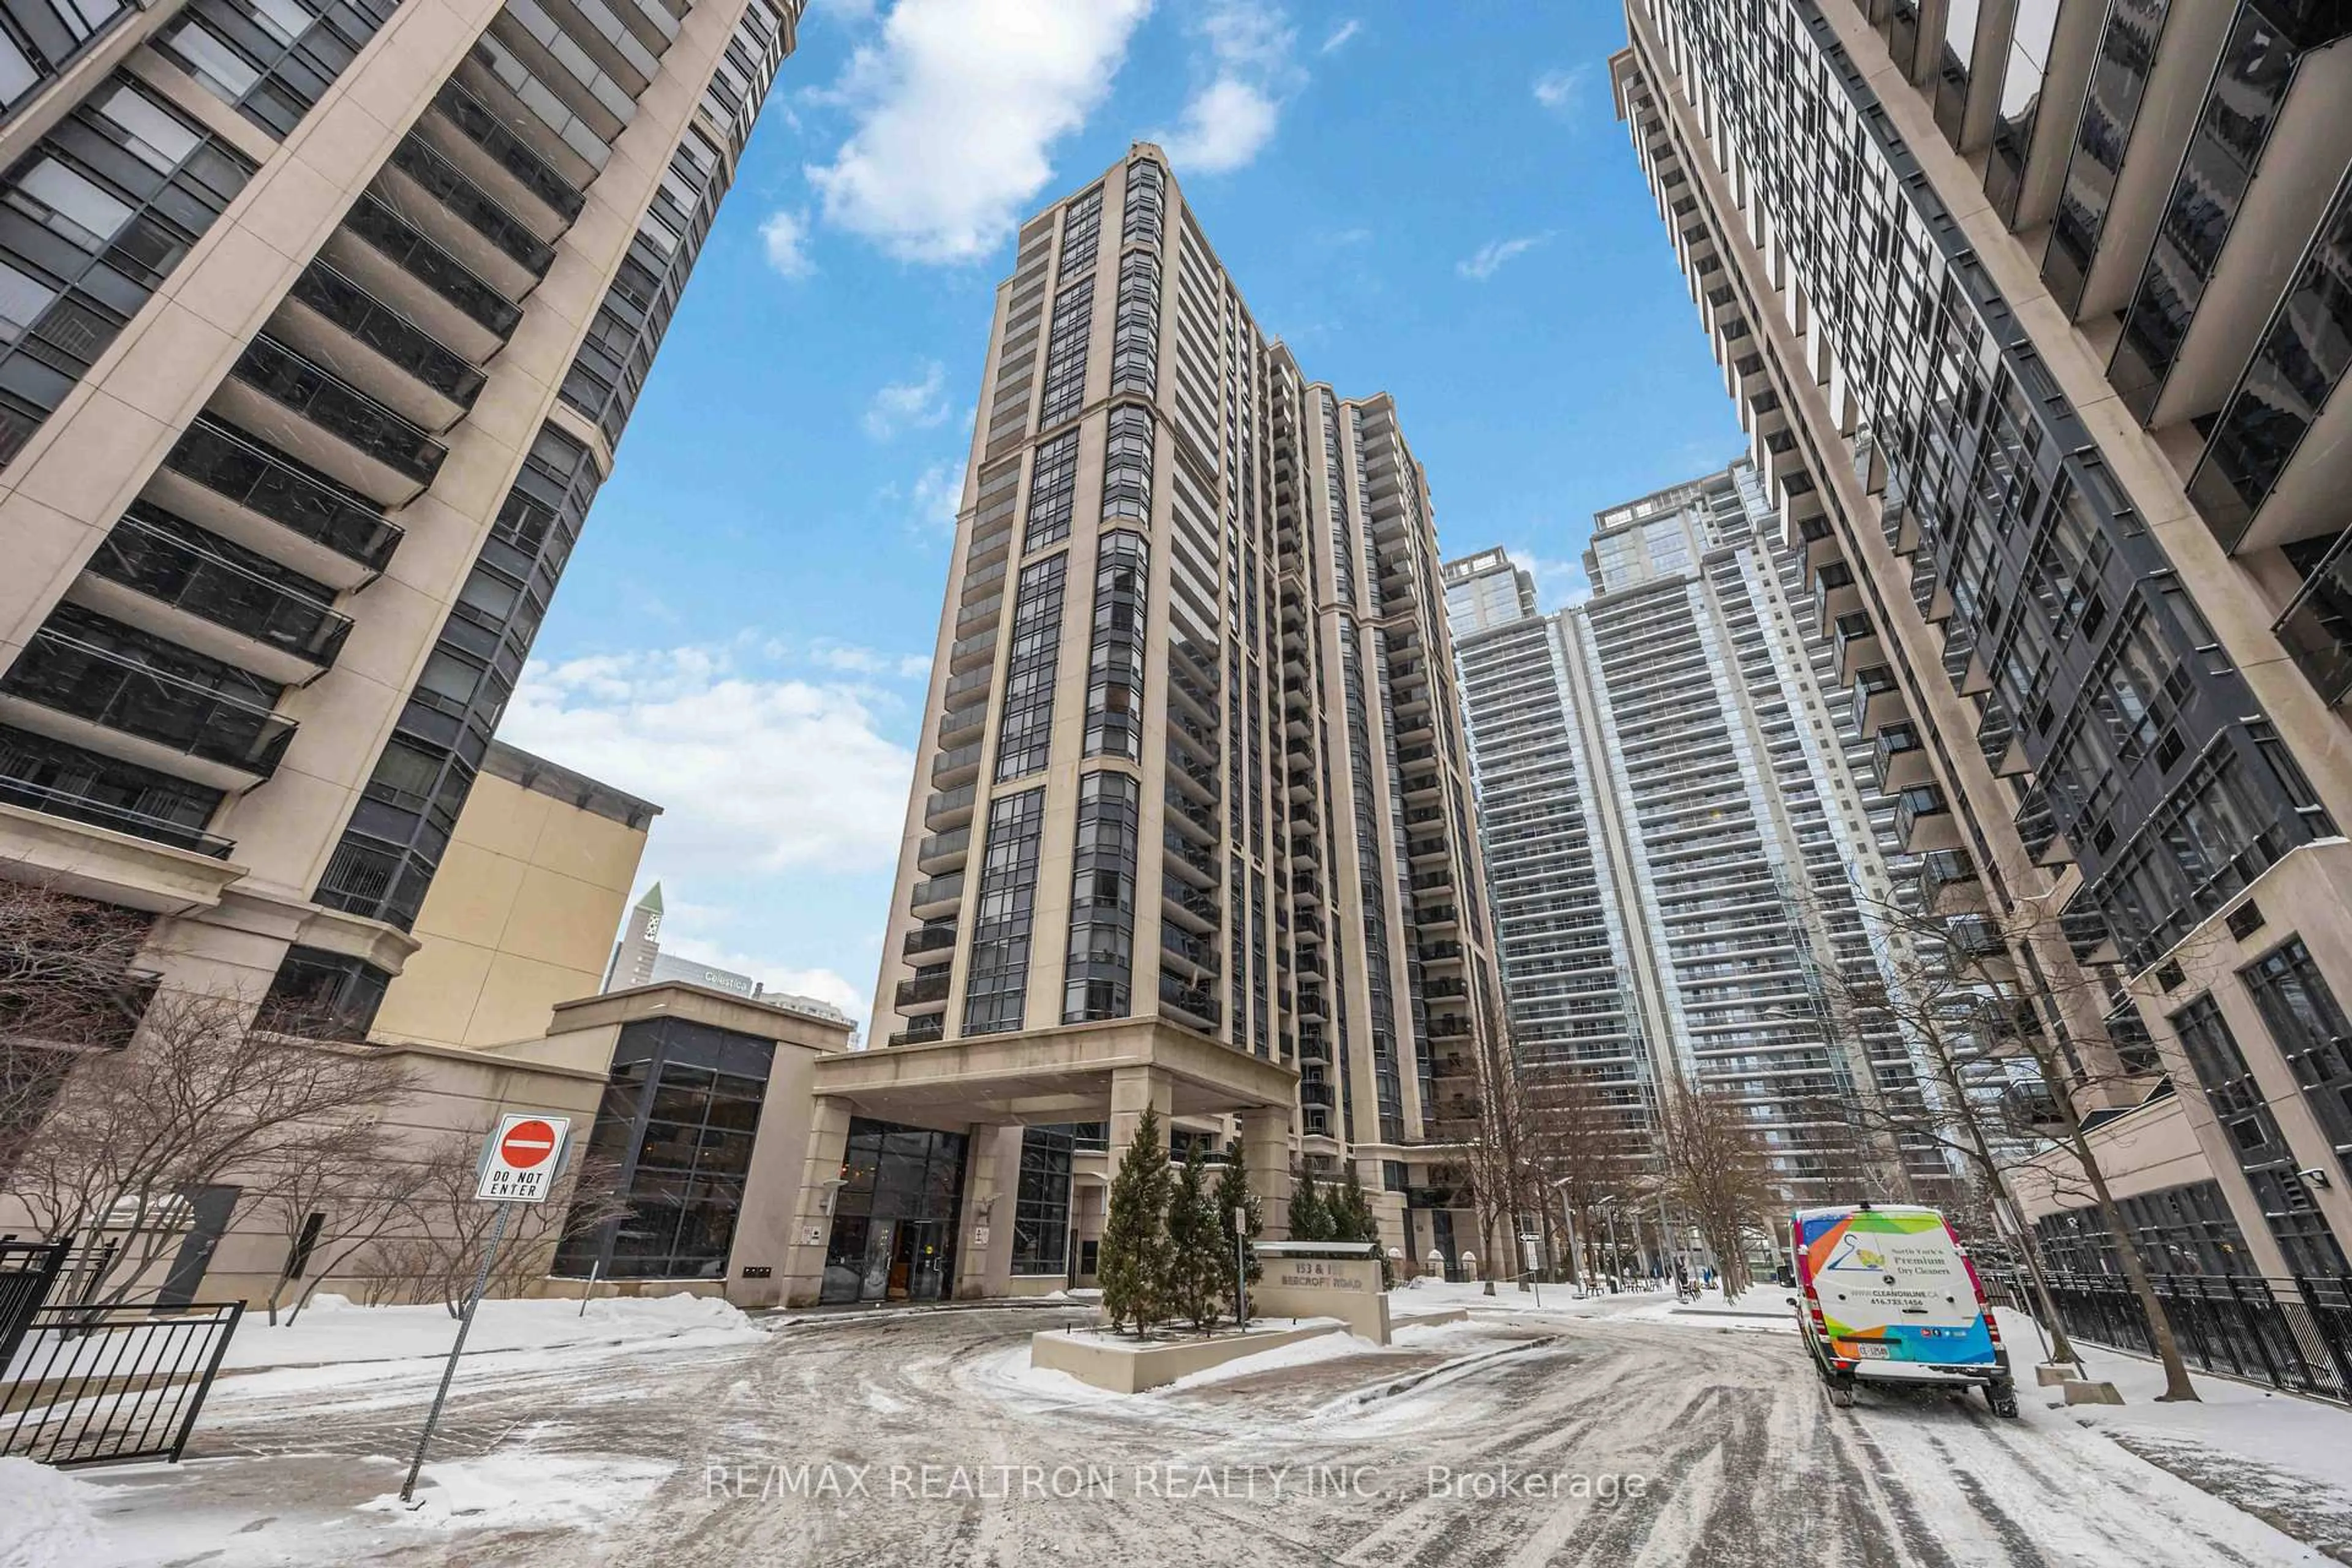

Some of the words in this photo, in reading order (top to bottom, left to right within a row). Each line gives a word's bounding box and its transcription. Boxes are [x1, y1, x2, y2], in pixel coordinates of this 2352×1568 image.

[493, 1170, 510, 1182] DO
[517, 1172, 543, 1184] NOT
[491, 1183, 537, 1196] ENTER
[1894, 1256, 1945, 1265] Premium
[1297, 1264, 1312, 1274] 153
[1315, 1264, 1324, 1275] &
[1915, 1267, 1951, 1275] Cleaners
[1282, 1275, 1331, 1287] BEECROFT
